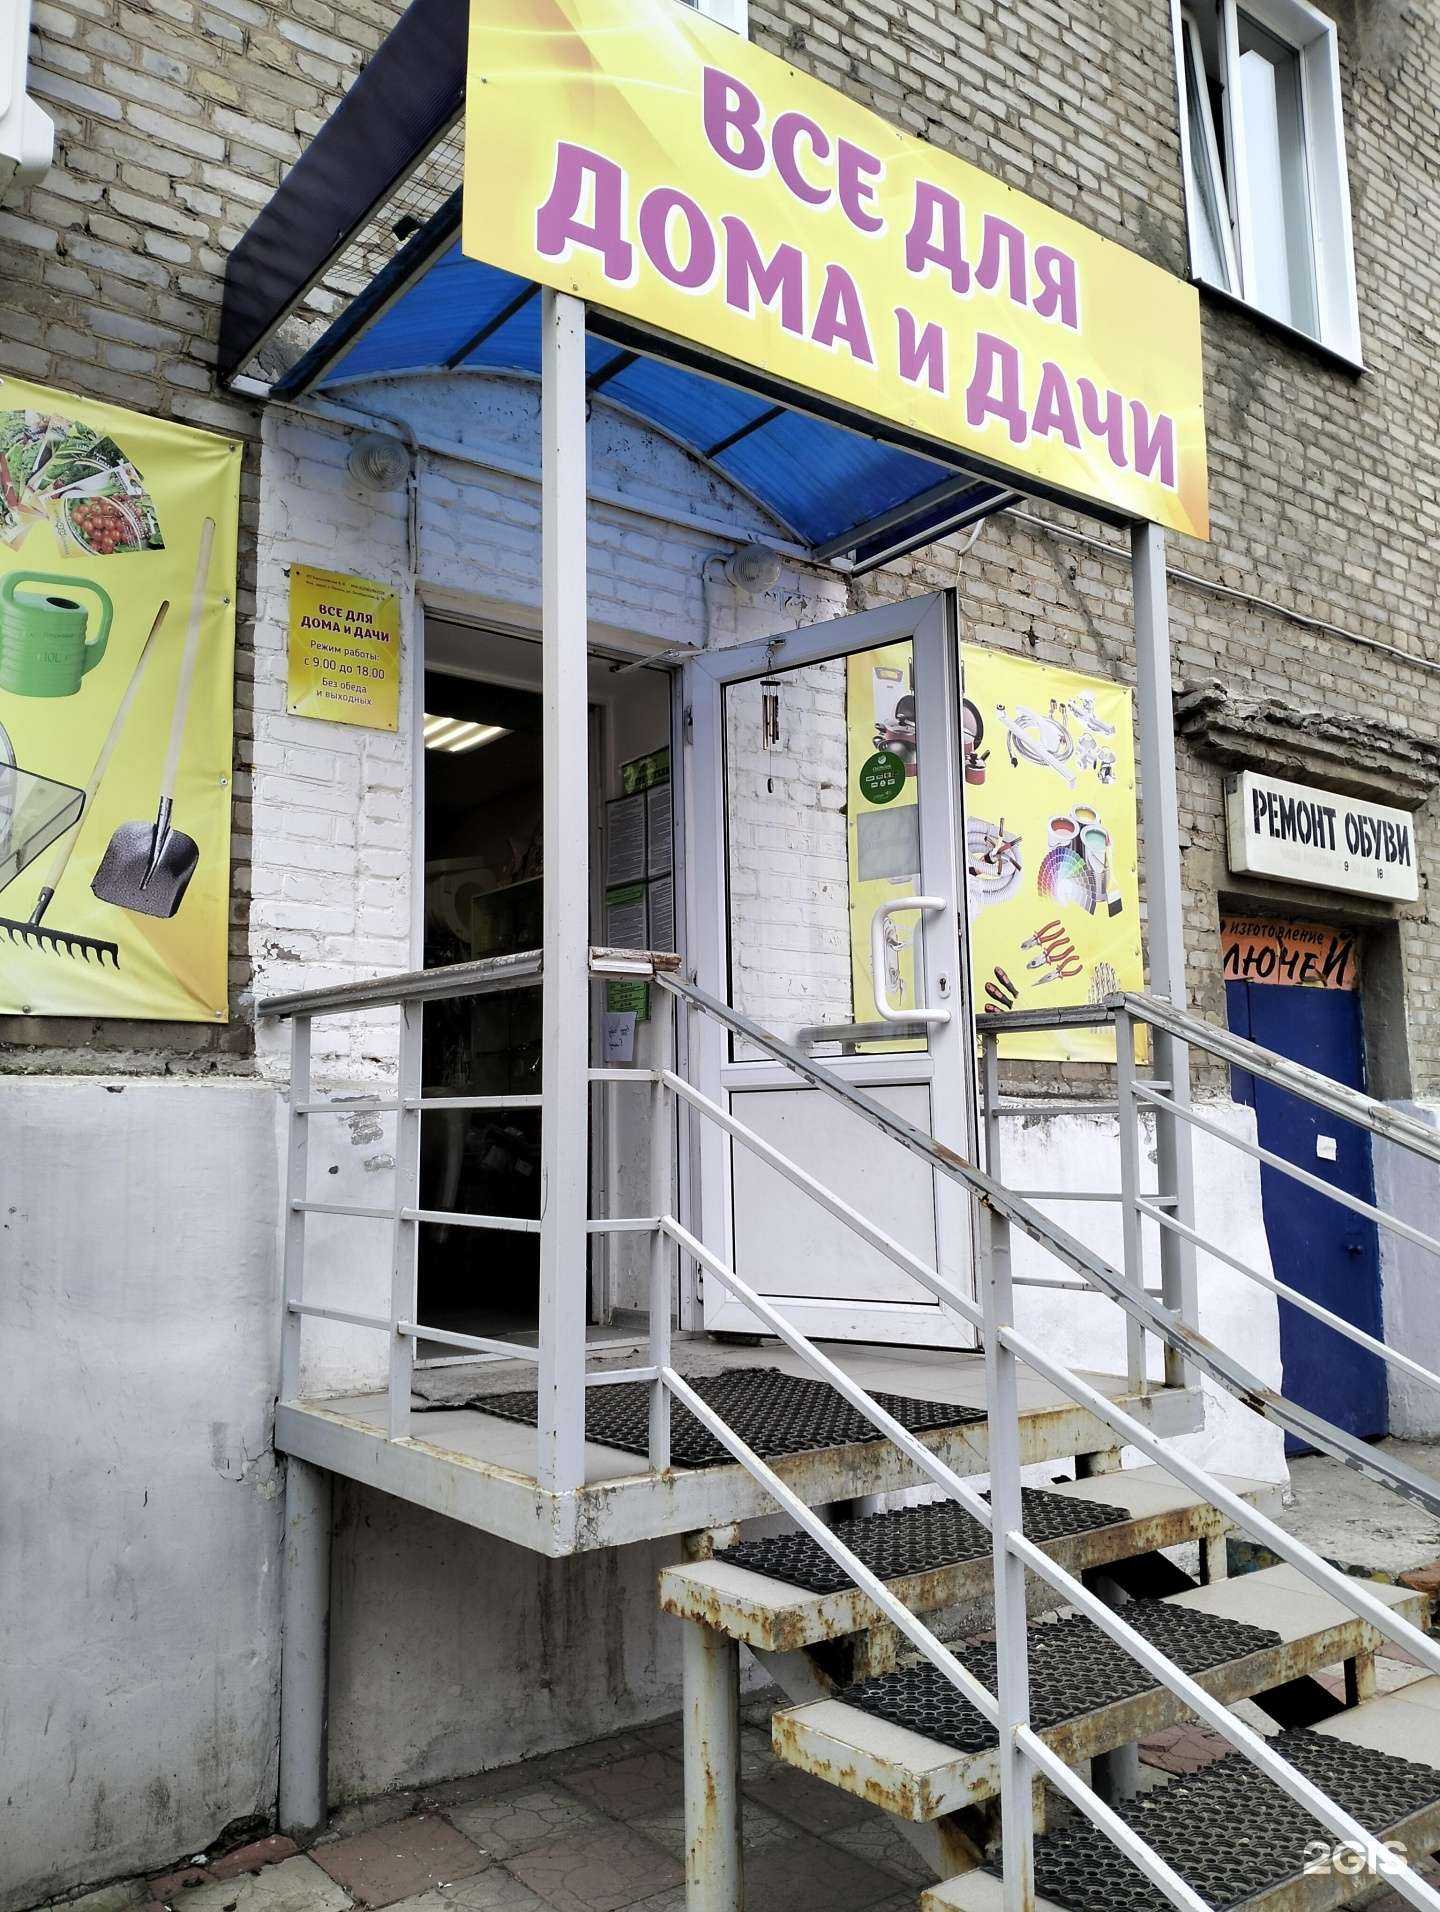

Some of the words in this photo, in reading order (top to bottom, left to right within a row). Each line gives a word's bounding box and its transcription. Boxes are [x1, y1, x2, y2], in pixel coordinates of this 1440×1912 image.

[702, 66, 885, 233] ВСЕ
[905, 180, 1080, 330] ДЛЯ
[536, 142, 874, 365] ДОМА
[966, 331, 1176, 489] ДАЧИ
[319, 604, 343, 618] ВСЕ
[345, 610, 373, 624] ДЛЯ
[301, 615, 341, 633] ДОМА
[353, 627, 390, 642] ДАЧИ
[310, 640, 341, 653] Режим
[344, 648, 380, 661] работы:
[304, 657, 309, 666] с
[312, 657, 336, 670] 9.00
[339, 664, 352, 674] до
[356, 665, 385, 680] 18.00
[322, 677, 338, 688] Без
[340, 682, 367, 694] обеда
[1252, 788, 1337, 851] РЕМОНТ
[1344, 812, 1412, 867] ОБУВИ
[1343, 860, 1350, 872] 9
[1229, 920, 1325, 945] изготовление
[1224, 932, 1354, 987] ЛЮЧЕЙ
